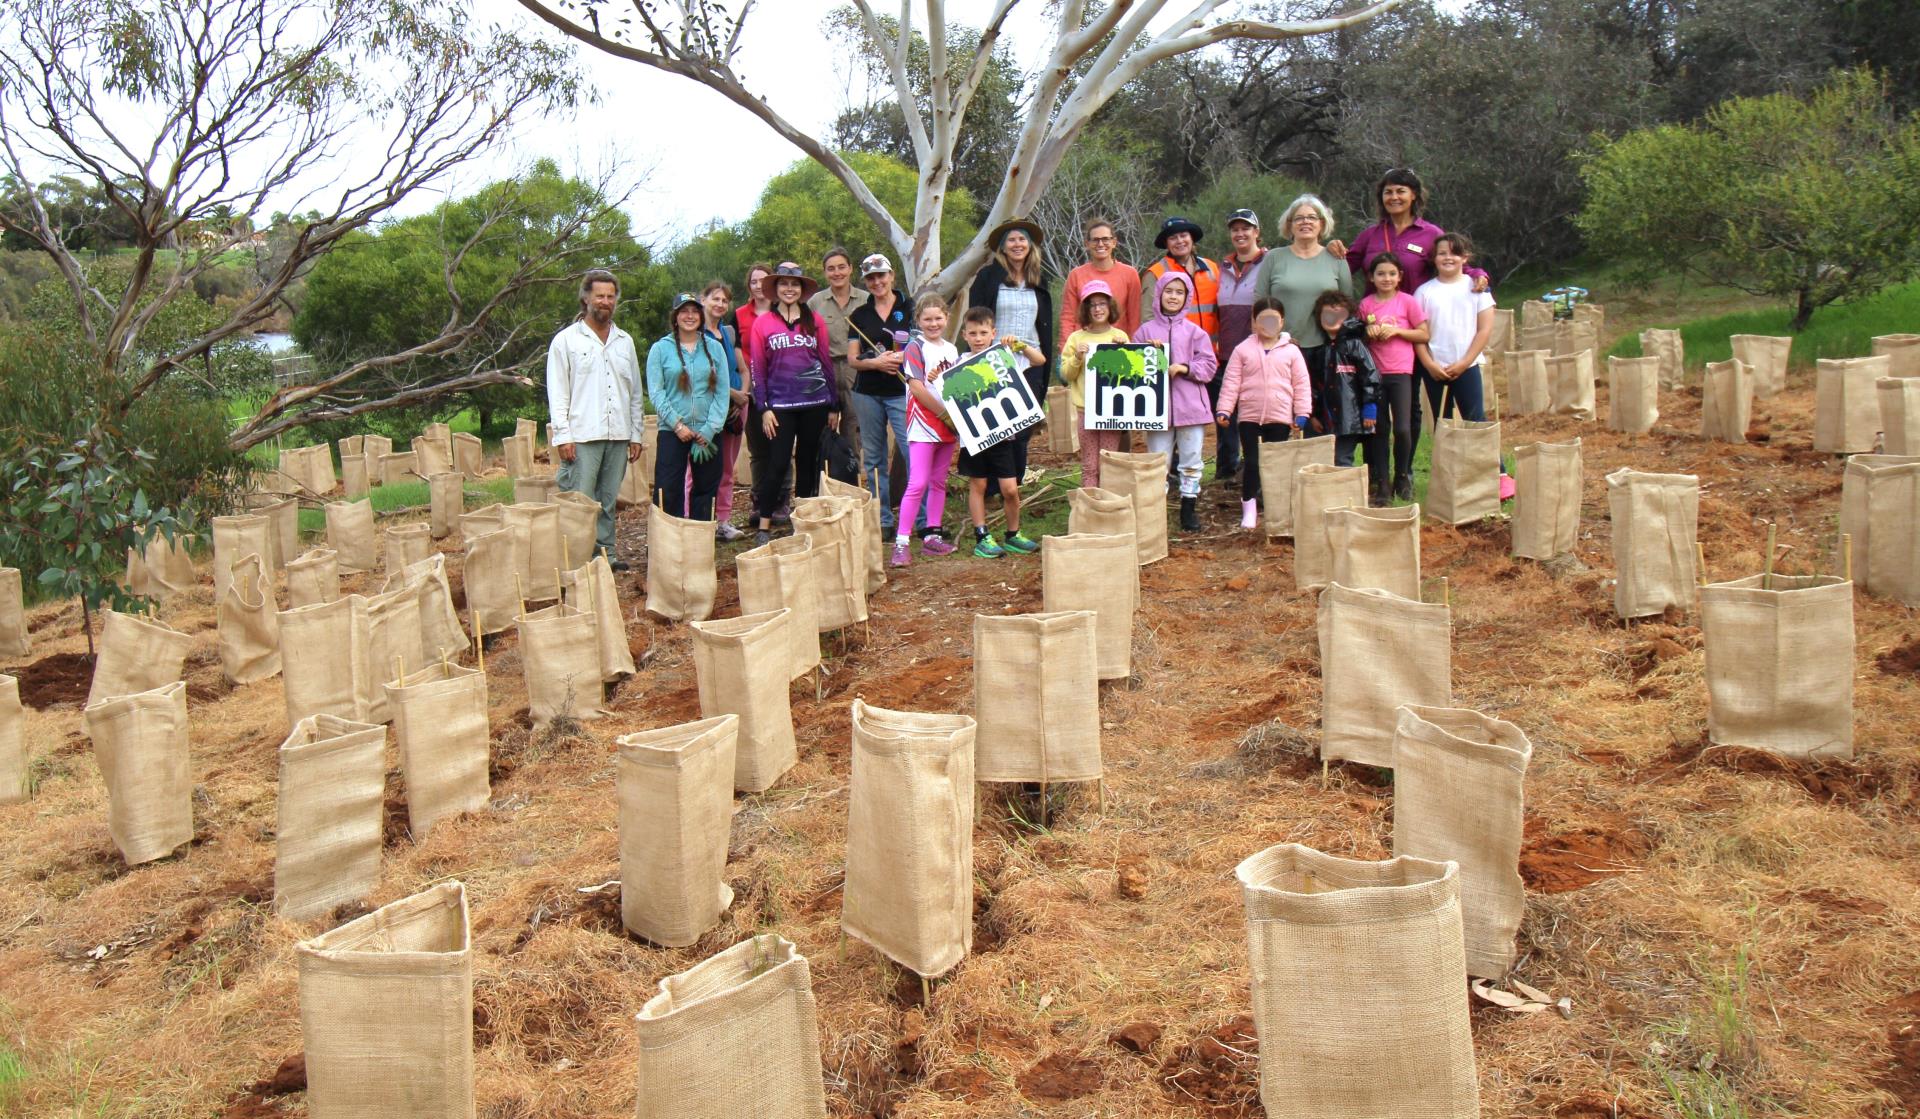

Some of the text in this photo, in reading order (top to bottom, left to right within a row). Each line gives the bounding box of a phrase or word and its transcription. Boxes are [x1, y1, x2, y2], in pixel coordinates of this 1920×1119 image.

[986, 351, 1013, 387] 2029
[1144, 346, 1157, 384] 2029
[978, 412, 1041, 450] million trees
[1096, 419, 1163, 429] million trees
